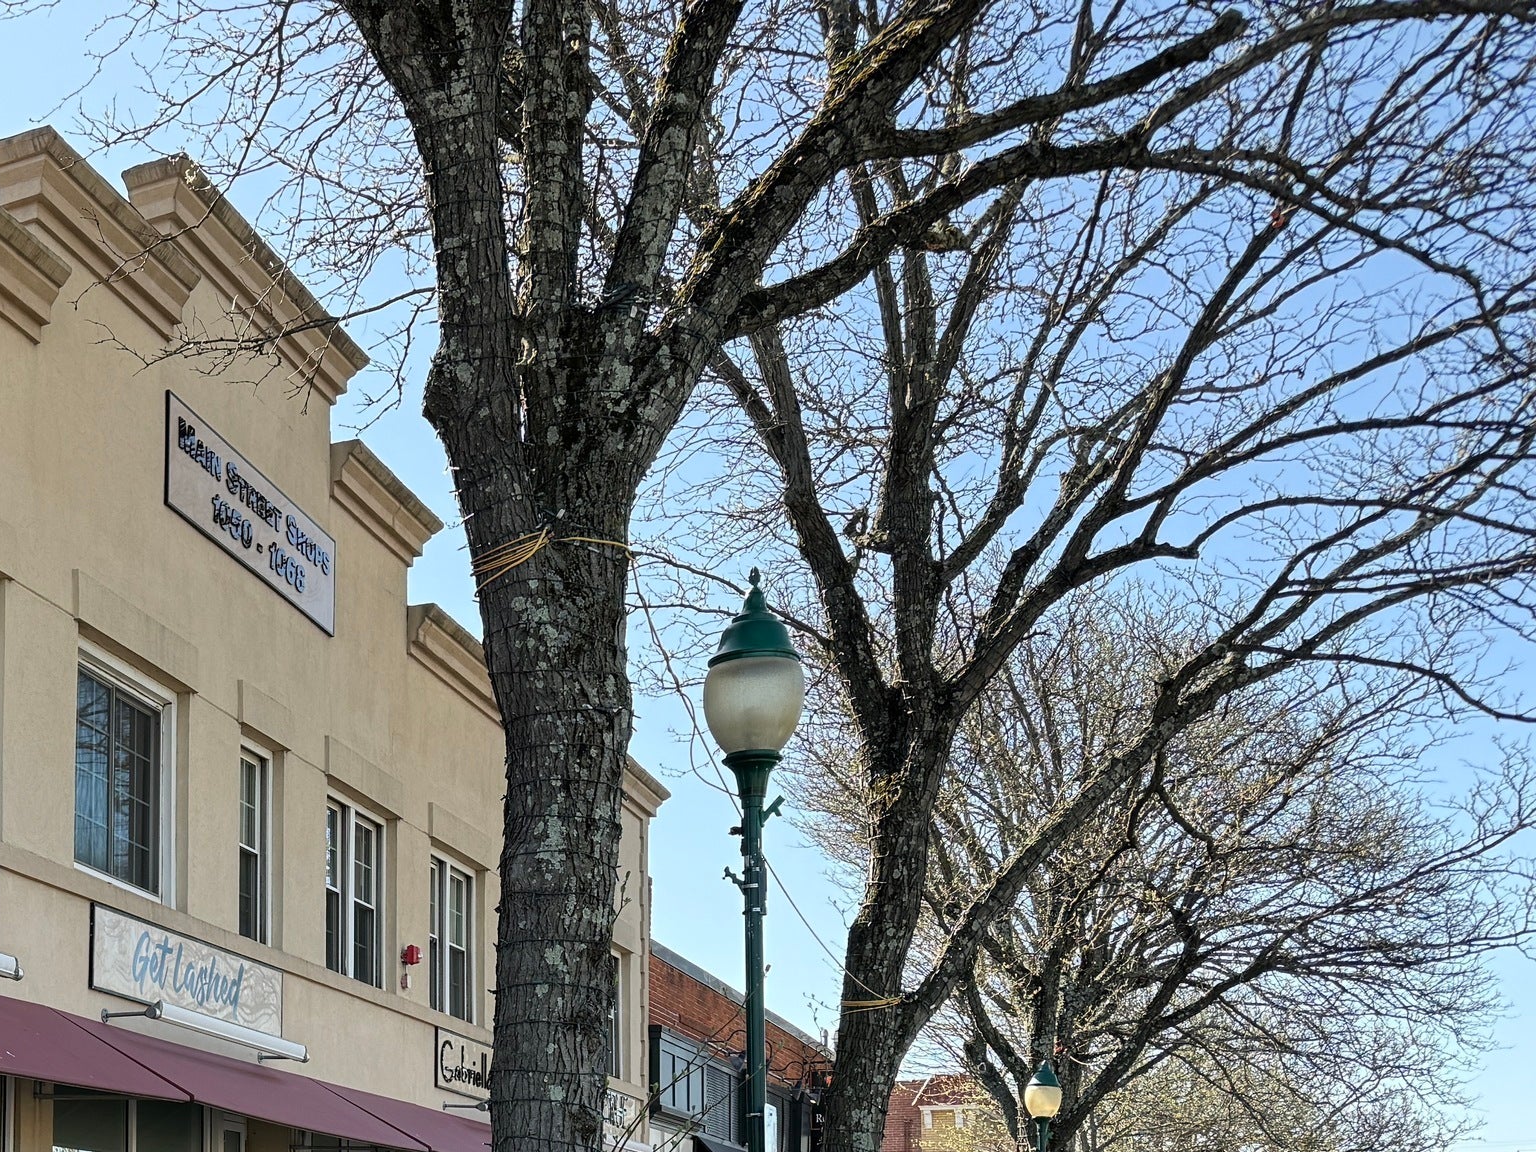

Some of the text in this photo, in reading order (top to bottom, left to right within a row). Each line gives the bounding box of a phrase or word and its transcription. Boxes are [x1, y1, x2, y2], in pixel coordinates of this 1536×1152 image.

[177, 415, 330, 576] MAIN STREET SHOPS
[210, 493, 253, 549] 1050
[268, 541, 307, 594] 1068
[132, 931, 245, 1021] Get Lashed
